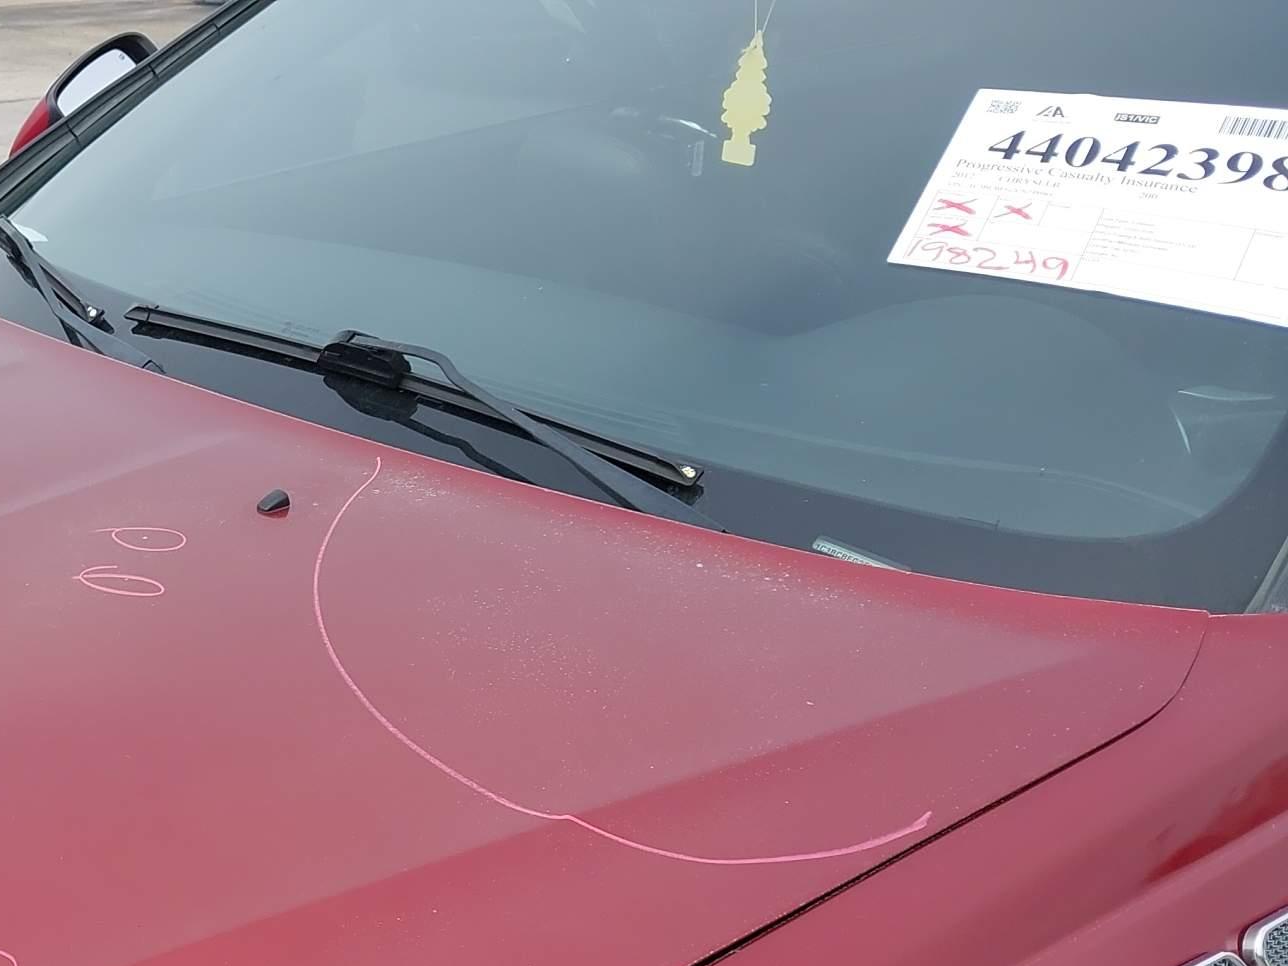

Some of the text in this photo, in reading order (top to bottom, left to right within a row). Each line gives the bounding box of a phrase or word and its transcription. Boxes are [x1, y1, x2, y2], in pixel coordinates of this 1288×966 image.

[956, 158, 1199, 193] Progressive Casualty Insurance
[988, 130, 1288, 191] 44042398
[908, 239, 1069, 280] 198249
